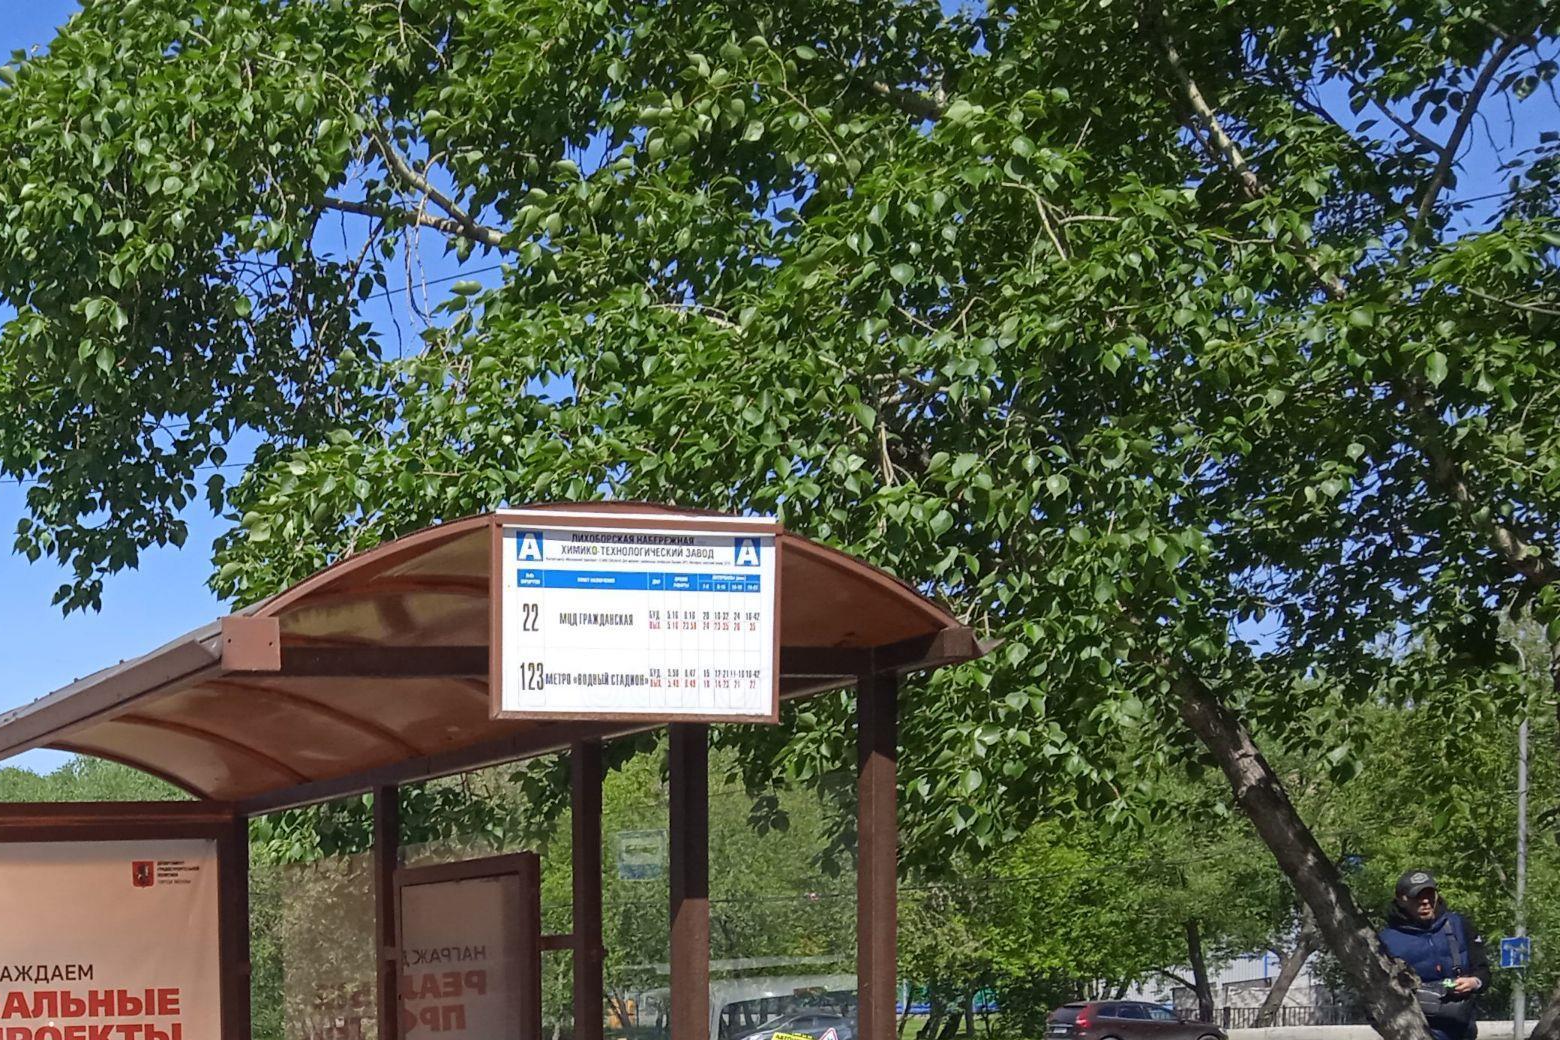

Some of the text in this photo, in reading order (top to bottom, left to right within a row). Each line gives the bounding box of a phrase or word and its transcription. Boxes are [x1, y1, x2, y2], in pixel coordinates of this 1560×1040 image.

[571, 533, 695, 546] ЛИХОБОРСКАЯ НАБЕРЕЖНАЯ
[561, 544, 714, 559] ХИМИКО-ТЕХНОЛОГИЧЕСКИЙ ЗАВОД
[523, 603, 539, 631] 22
[559, 612, 633, 626] МЦД ГРАЖДАНСКАЯ
[520, 662, 544, 690] 123
[545, 672, 571, 685] МЕТРО
